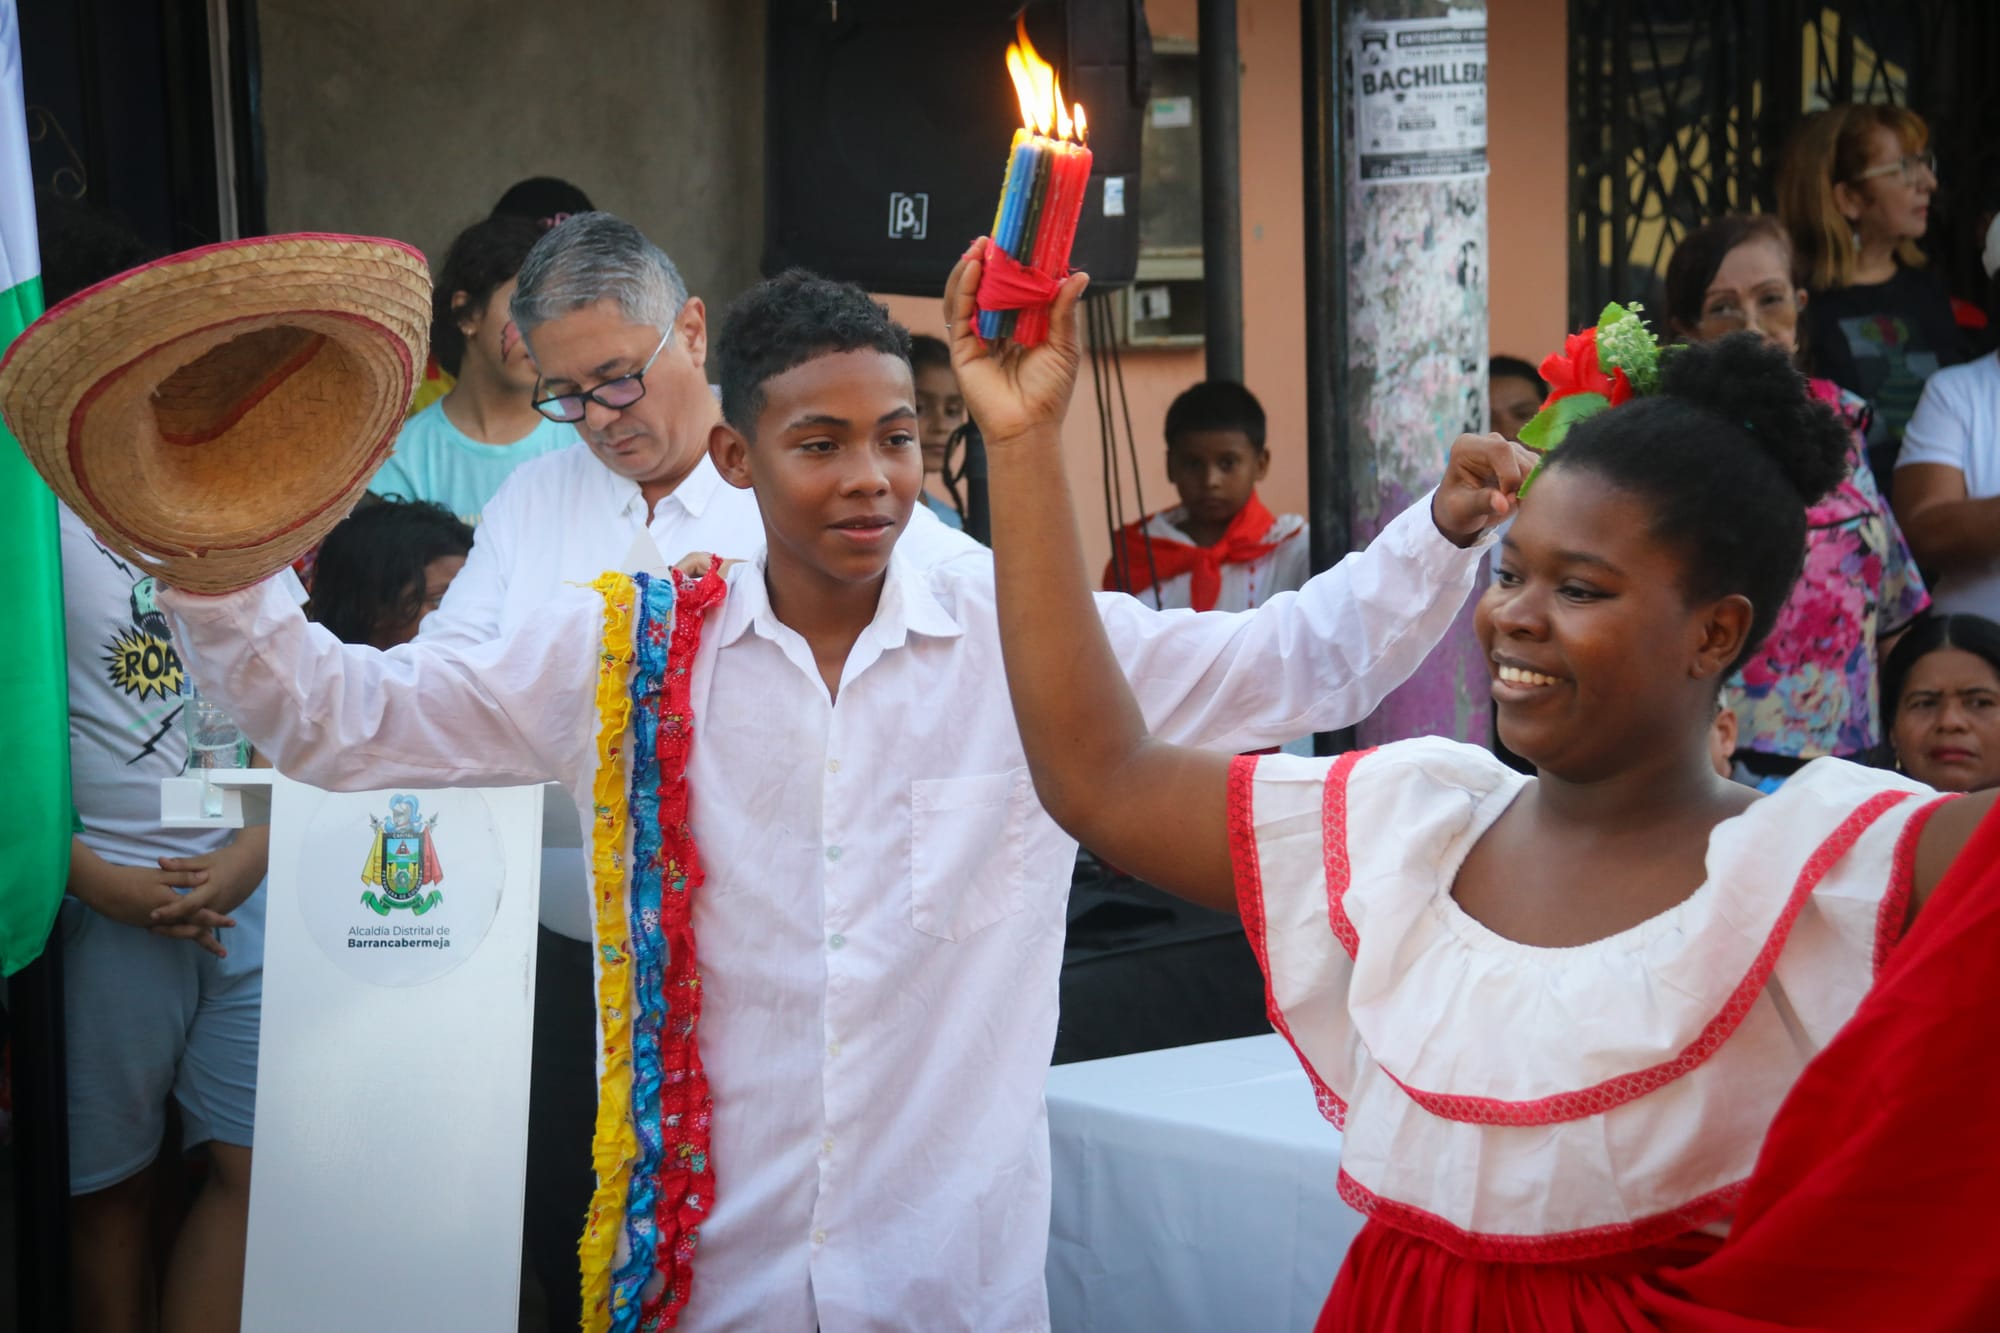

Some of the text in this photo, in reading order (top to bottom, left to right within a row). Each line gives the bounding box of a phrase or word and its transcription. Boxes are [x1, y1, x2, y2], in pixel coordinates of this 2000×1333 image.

[348, 925, 450, 935] Alcaldía Distrital de
[348, 937, 451, 950] Barrancabermeja
